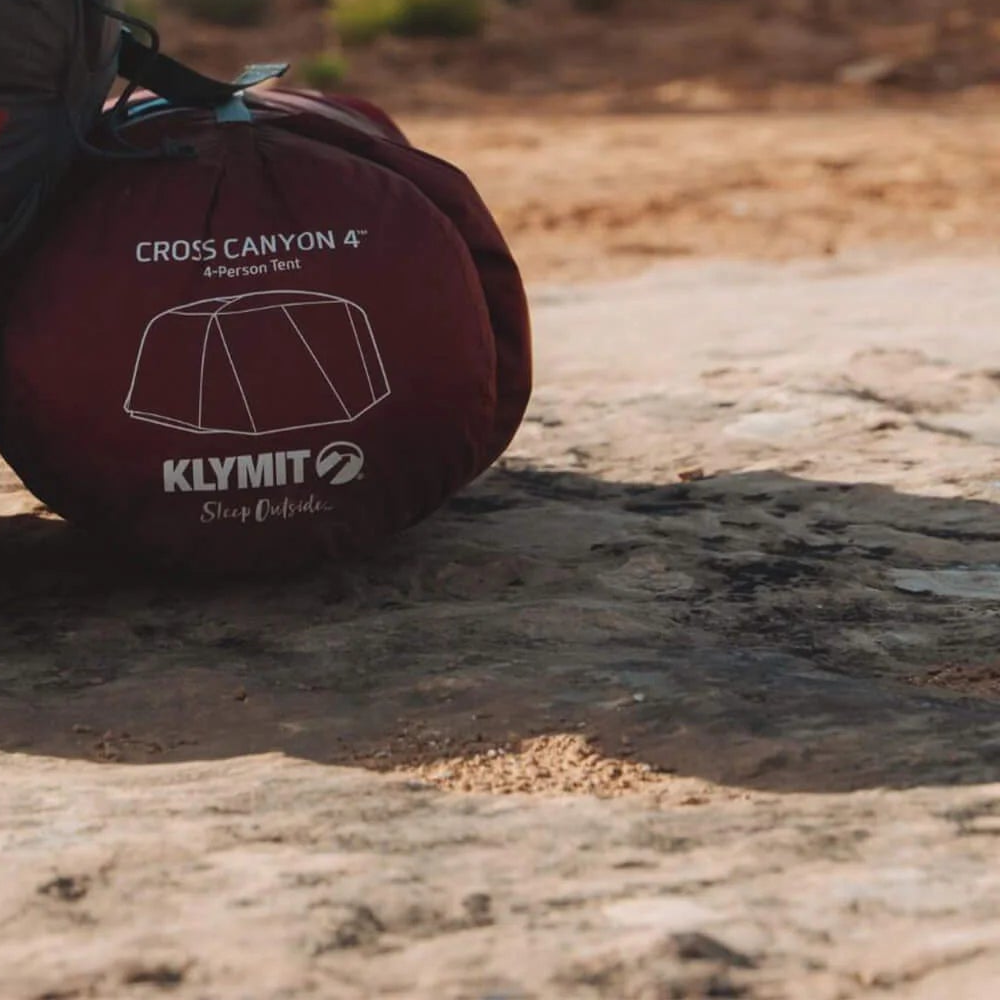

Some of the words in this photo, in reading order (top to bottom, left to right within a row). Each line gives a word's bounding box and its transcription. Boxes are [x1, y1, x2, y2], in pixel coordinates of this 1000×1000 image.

[136, 239, 217, 262] CROSS
[223, 230, 335, 259] CANYON
[203, 264, 268, 278] 4-Person
[270, 258, 301, 272] Tent
[163, 450, 311, 493] KLYMIT
[200, 501, 250, 523] Sleep
